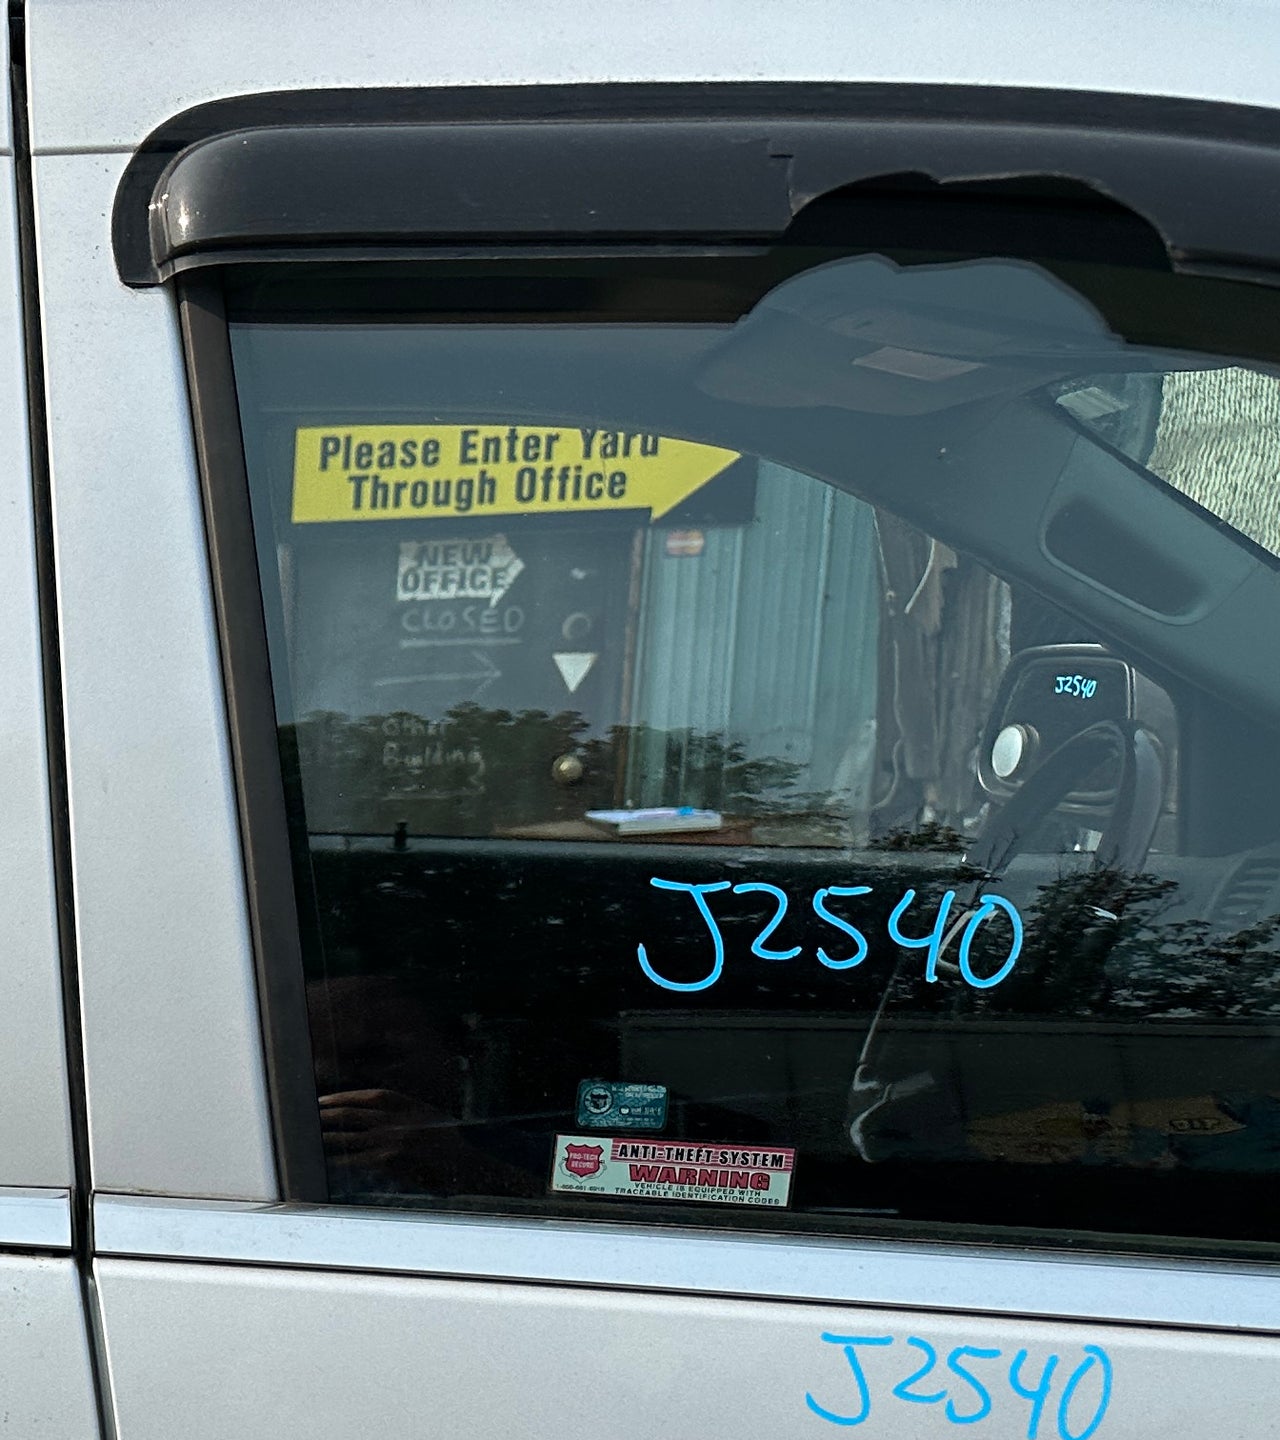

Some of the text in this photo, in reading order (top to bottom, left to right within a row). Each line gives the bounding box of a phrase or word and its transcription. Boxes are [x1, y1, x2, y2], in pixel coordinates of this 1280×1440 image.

[319, 433, 440, 472] Please
[459, 428, 560, 466] Enter
[348, 465, 627, 513] Through Office
[414, 543, 493, 567] NEW
[401, 567, 508, 594] OFFICE
[1054, 674, 1098, 699] J2540
[636, 876, 1024, 991] J2540
[618, 1143, 785, 1169] ANTI-THEFT SYSTEM
[628, 1163, 771, 1191] WARNING
[634, 1182, 674, 1192] VEHICLE
[688, 1186, 735, 1196] EQUIPPED
[737, 1189, 761, 1197] WITH
[615, 1187, 780, 1206] TRACEABLE IDENTIFICATION CODES
